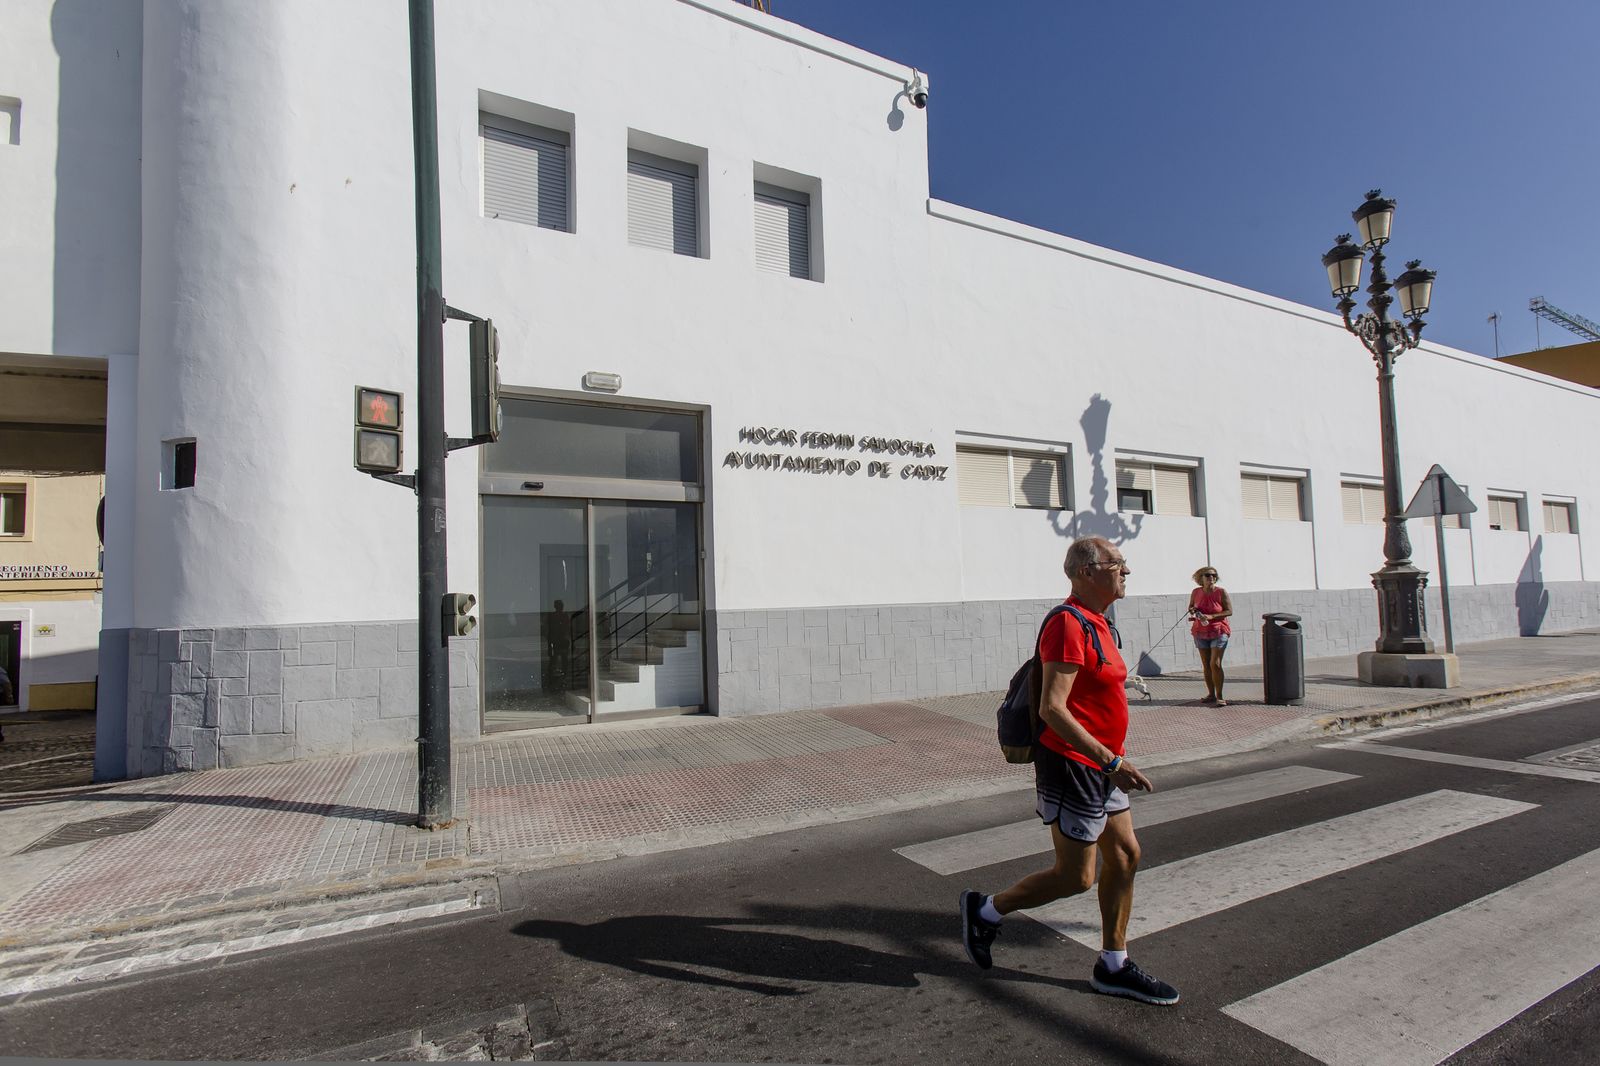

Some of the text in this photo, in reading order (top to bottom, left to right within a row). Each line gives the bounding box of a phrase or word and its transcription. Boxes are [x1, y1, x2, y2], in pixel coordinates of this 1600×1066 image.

[739, 426, 936, 458] HOGAR FERMIN SALVOCHEA
[722, 451, 861, 476] AYUNTAMIENTO
[867, 460, 892, 478] DE
